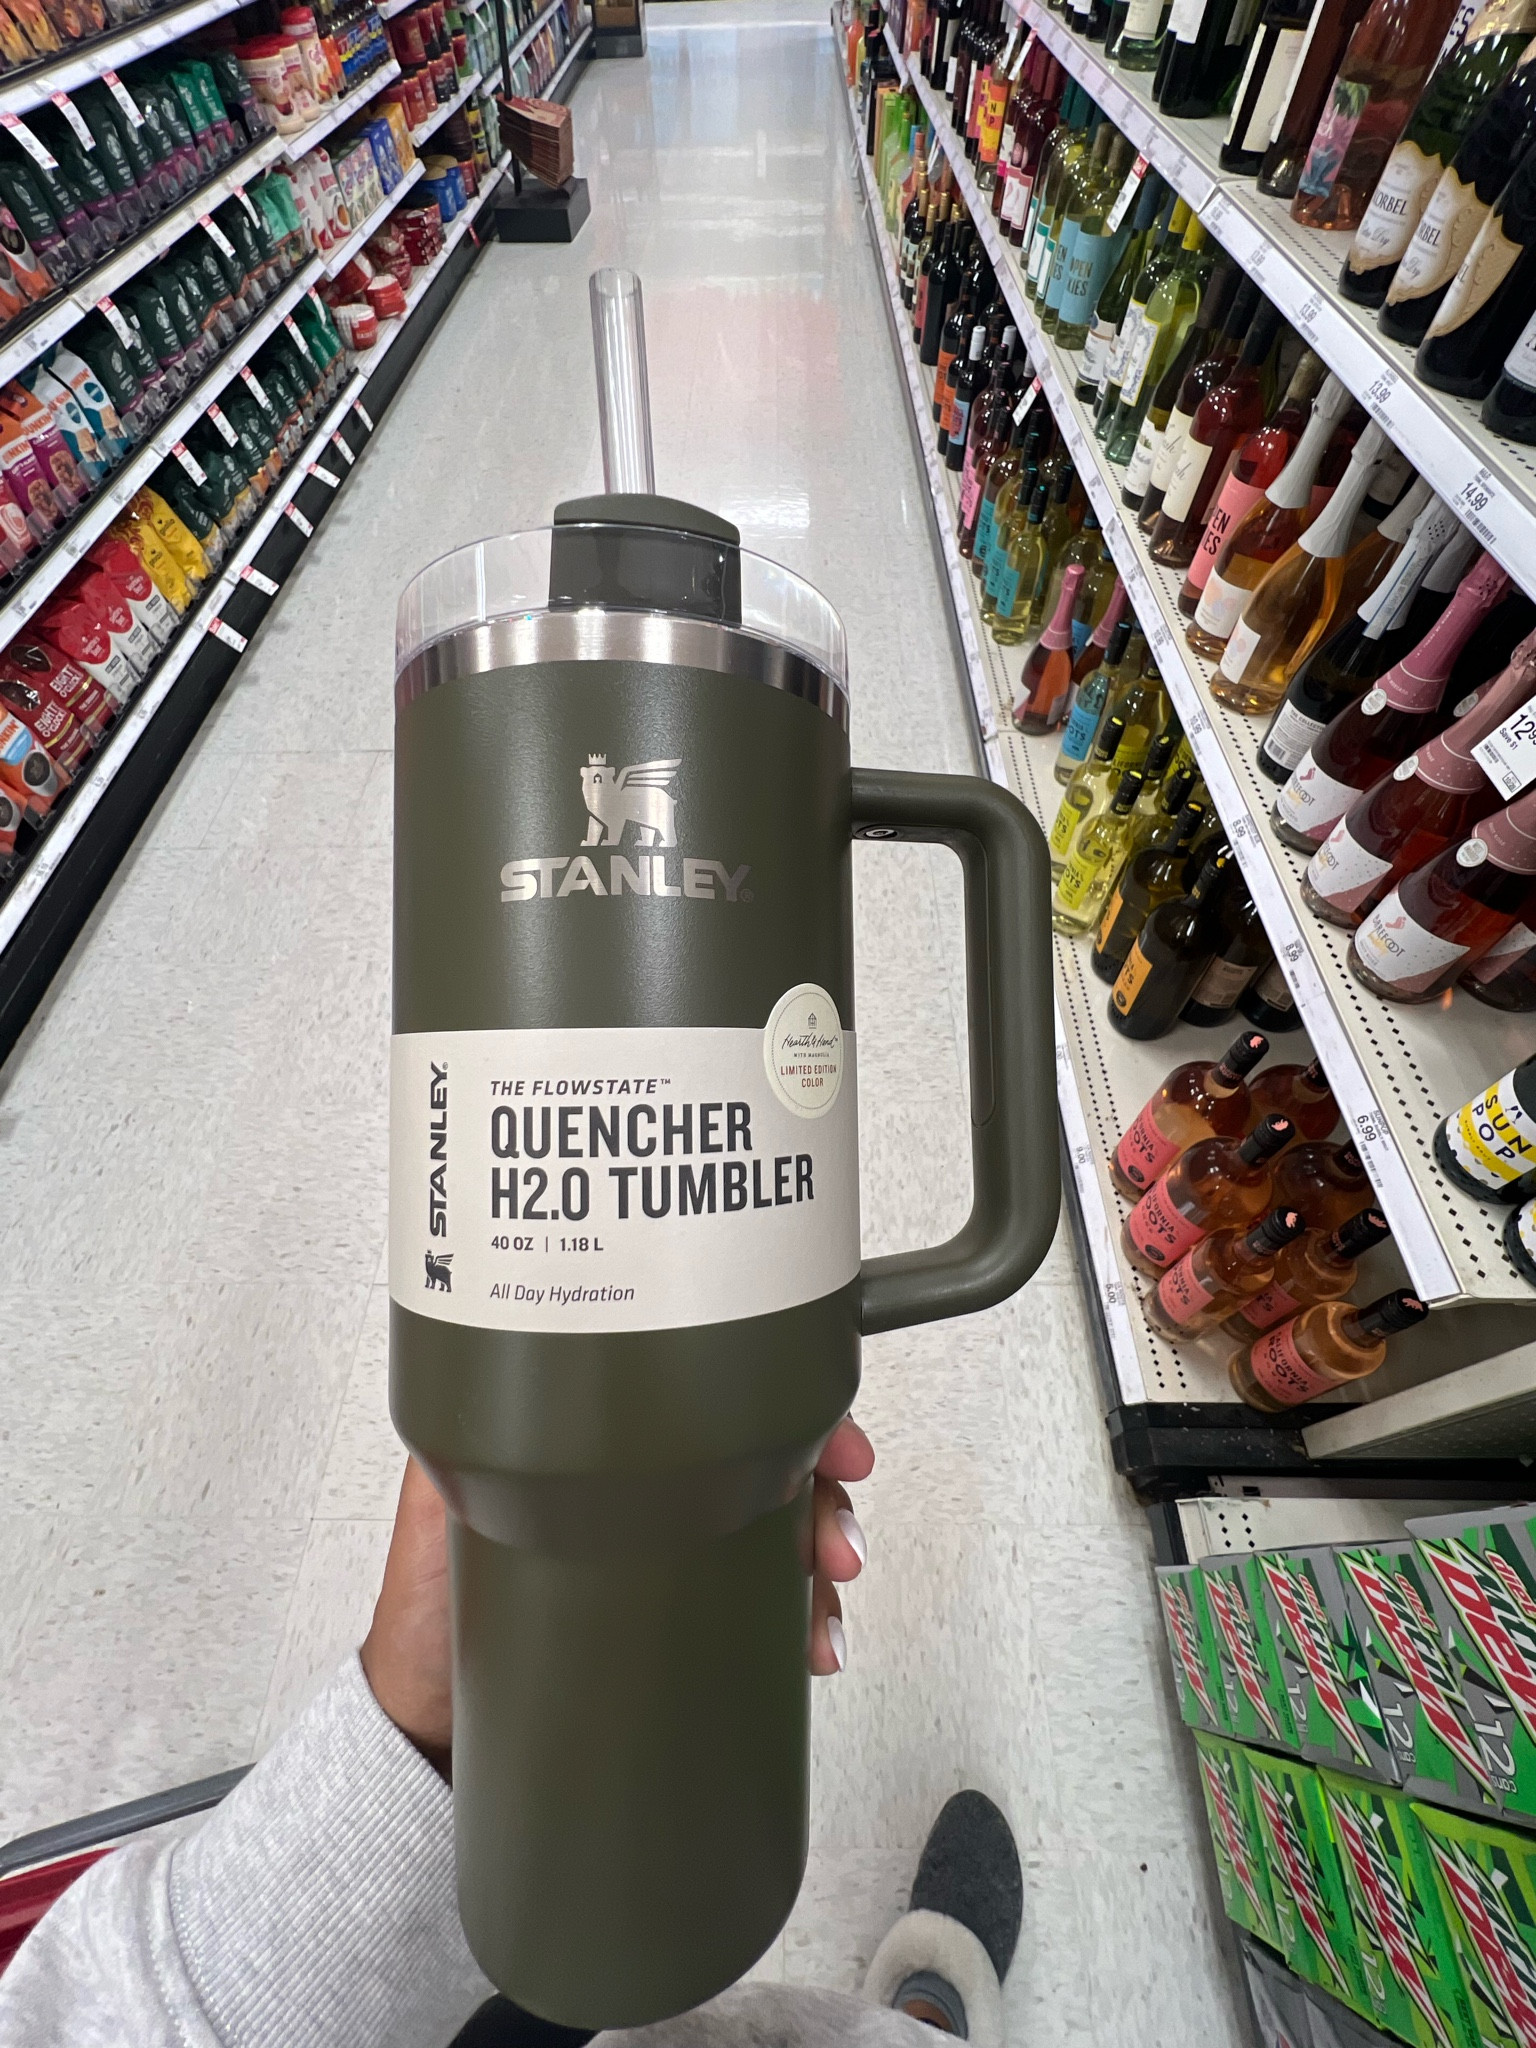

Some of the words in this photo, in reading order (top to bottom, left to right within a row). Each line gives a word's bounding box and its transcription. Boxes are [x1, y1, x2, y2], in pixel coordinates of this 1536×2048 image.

[1369, 380, 1391, 403] 13.99
[1461, 482, 1488, 511] 14.99
[49, 663, 74, 692] EIGHT
[34, 699, 59, 733] EIGHT
[1500, 728, 1512, 743] Save
[1232, 819, 1247, 839] 8.99
[1285, 943, 1299, 962] 8.99
[780, 1065, 812, 1076] LIMITED
[814, 1064, 837, 1074] EDITION
[801, 1077, 824, 1088] COLOR
[490, 1080, 525, 1096] THE
[491, 1101, 753, 1159] QUENCHER
[1357, 1114, 1377, 1142] 6.99
[1472, 1102, 1516, 1159] POP
[1485, 1094, 1533, 1154] SUN
[608, 1153, 815, 1220] TUMBLER
[491, 1236, 509, 1250] 40
[513, 1236, 534, 1251] OZ
[560, 1237, 589, 1251] 1.18
[593, 1238, 604, 1251] L
[490, 1283, 510, 1299] All
[514, 1285, 545, 1305] Day
[549, 1285, 635, 1306] Hydration
[1395, 1573, 1438, 1633] diet
[1287, 1683, 1308, 1728] 12
[1382, 1702, 1415, 1749] 12
[1473, 1719, 1517, 1780] 12
[1361, 1951, 1385, 2001] 12
